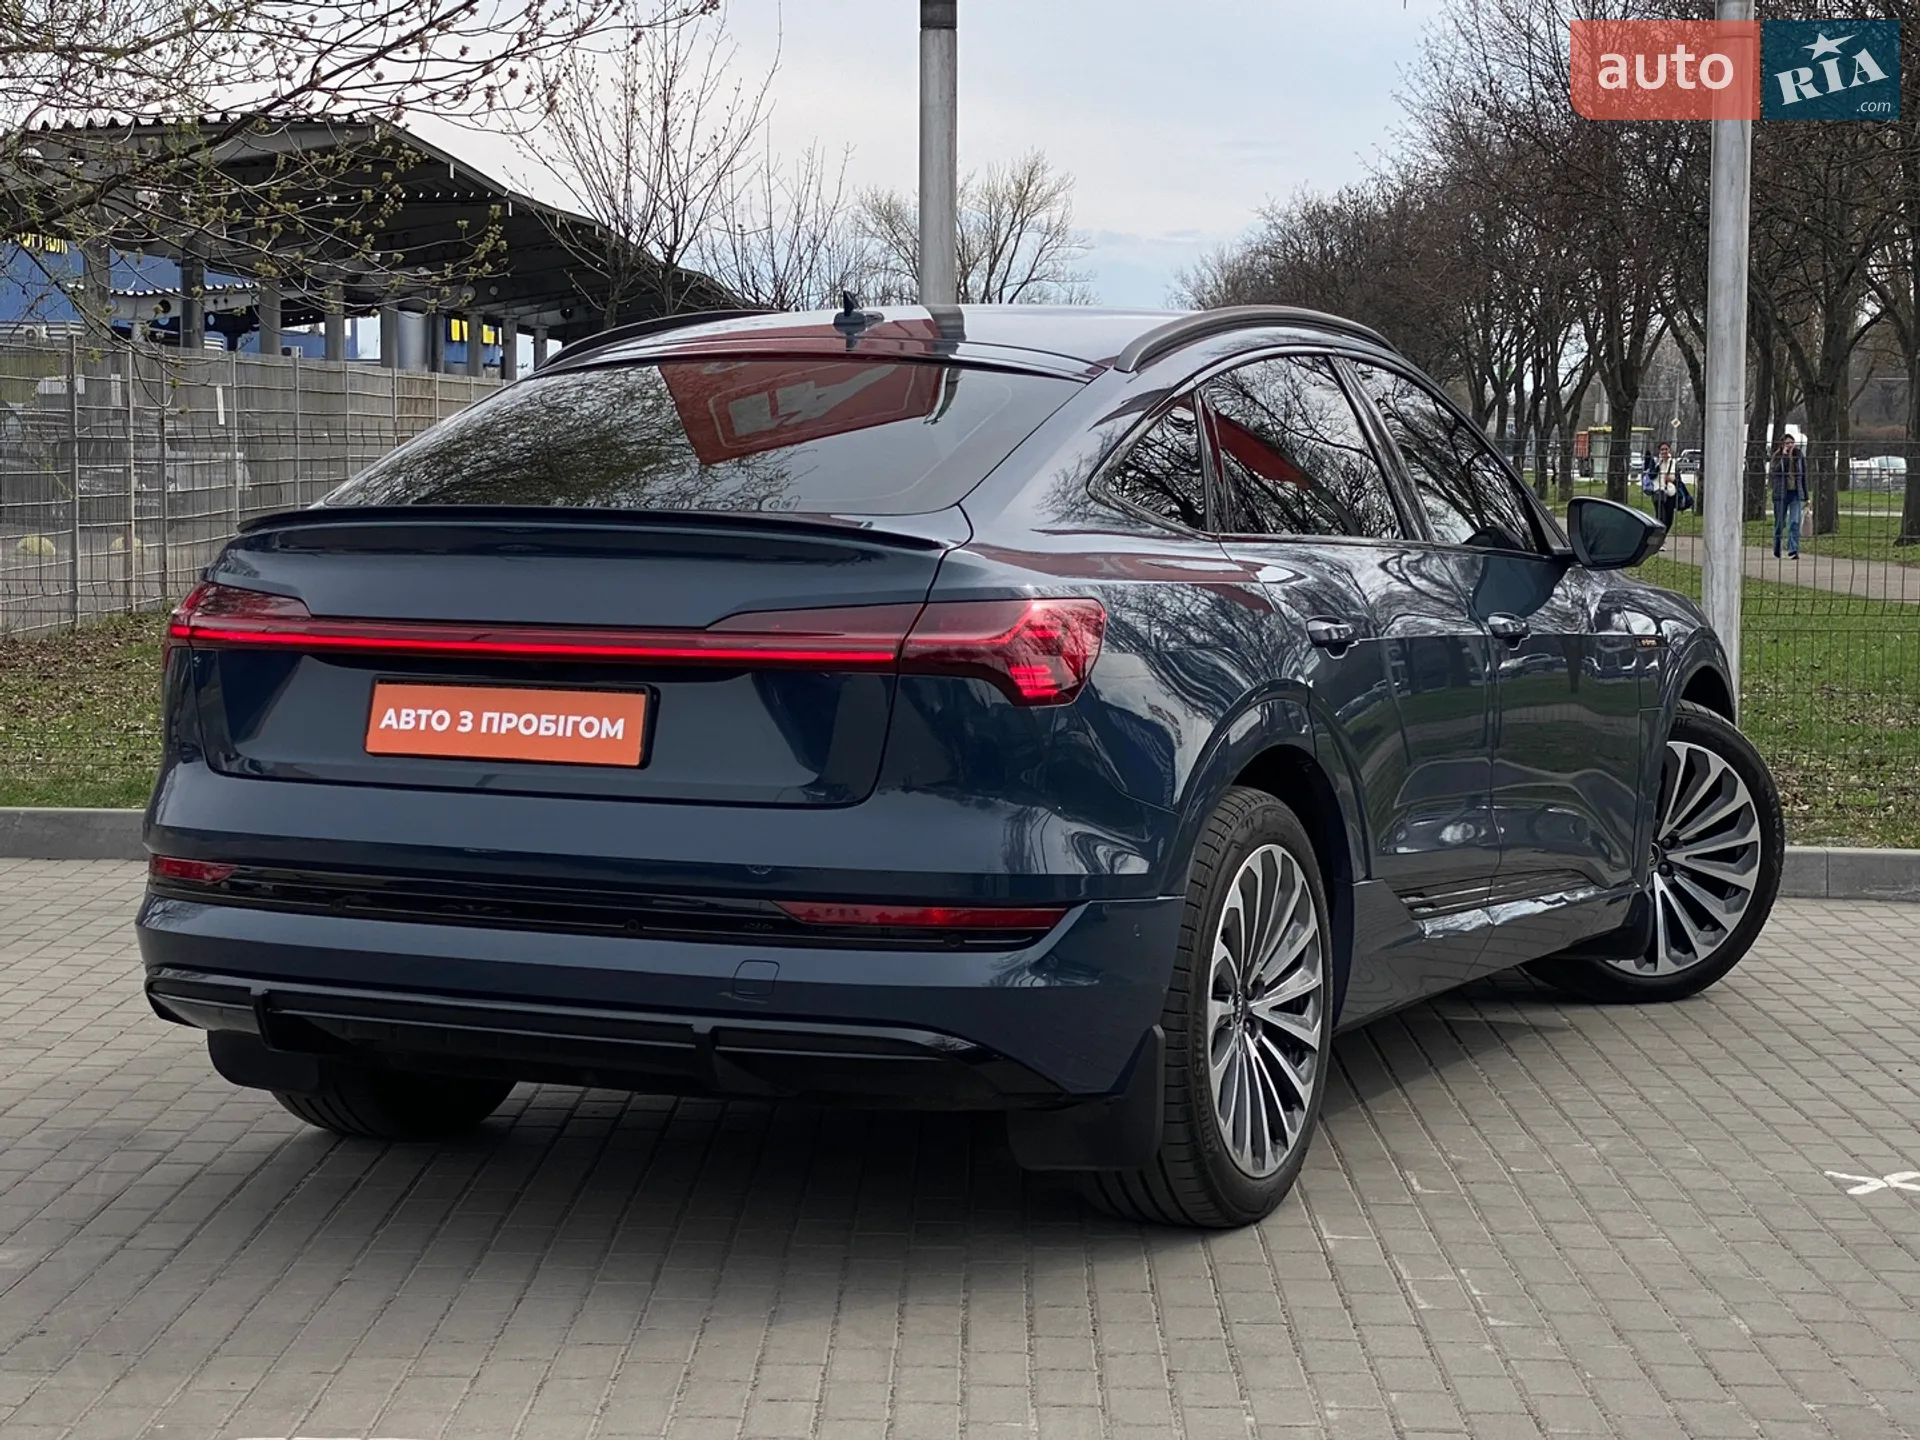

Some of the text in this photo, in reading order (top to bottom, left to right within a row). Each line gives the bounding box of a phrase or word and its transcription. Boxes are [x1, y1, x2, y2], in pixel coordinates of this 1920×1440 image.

[379, 707, 625, 740] АВТО З ПРОБІГОМ
